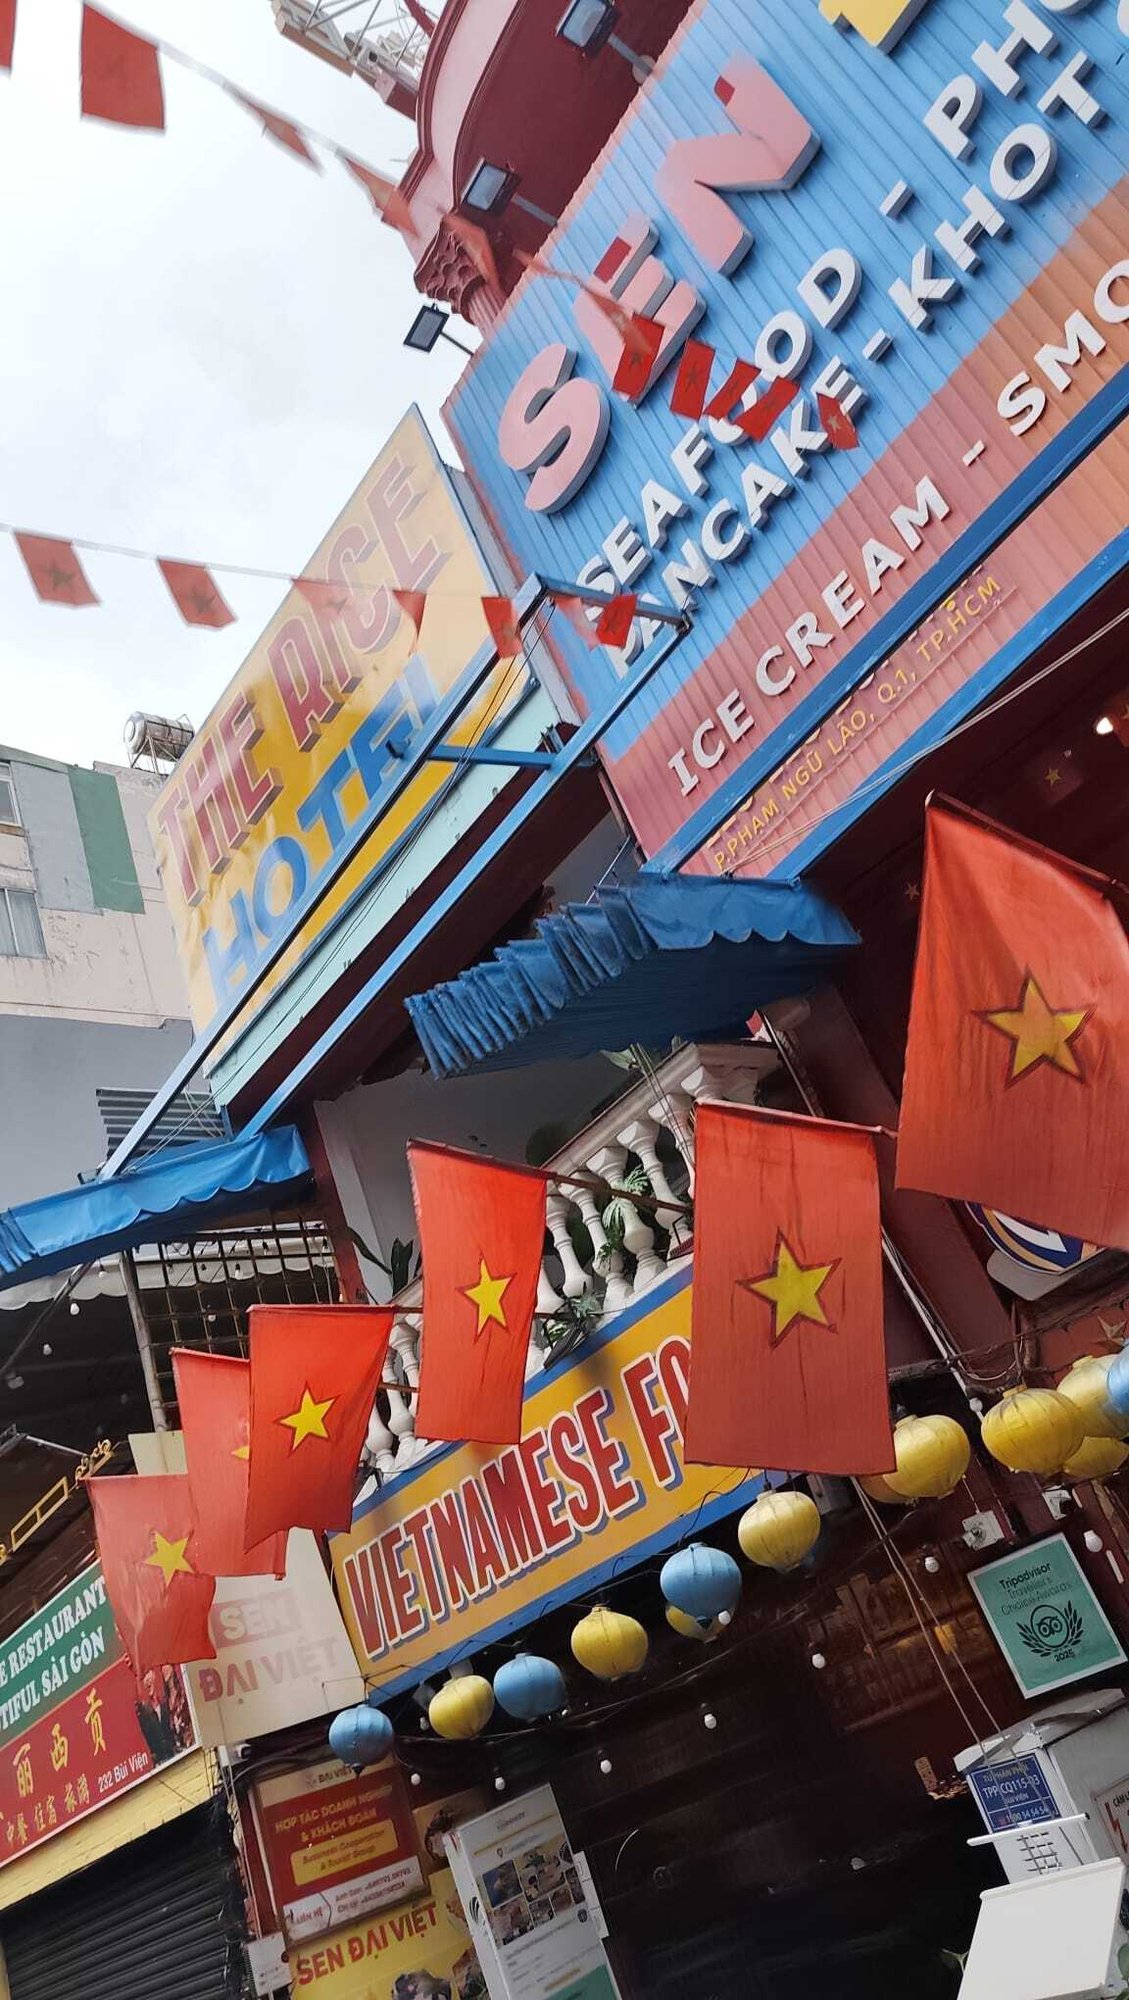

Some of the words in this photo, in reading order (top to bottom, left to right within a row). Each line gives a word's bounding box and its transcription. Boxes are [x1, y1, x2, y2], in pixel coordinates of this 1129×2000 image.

[923, 0, 1106, 163] PH
[499, 50, 823, 514] SEN
[668, 689, 755, 797] ICE
[755, 475, 951, 697] CREAM
[996, 259, 1129, 437] SMO
[917, 576, 1000, 662] TP.HCM
[155, 685, 284, 907] THE
[202, 652, 446, 1000] HOTEL
[343, 1385, 646, 1663] VIETNAMESE
[1000, 1562, 1052, 1590] Tripadvisor
[8, 1575, 107, 1679] RESTAURANT
[220, 1594, 295, 1640] SEN
[98, 1771, 114, 1793] 232
[297, 1943, 345, 1986] SEN
